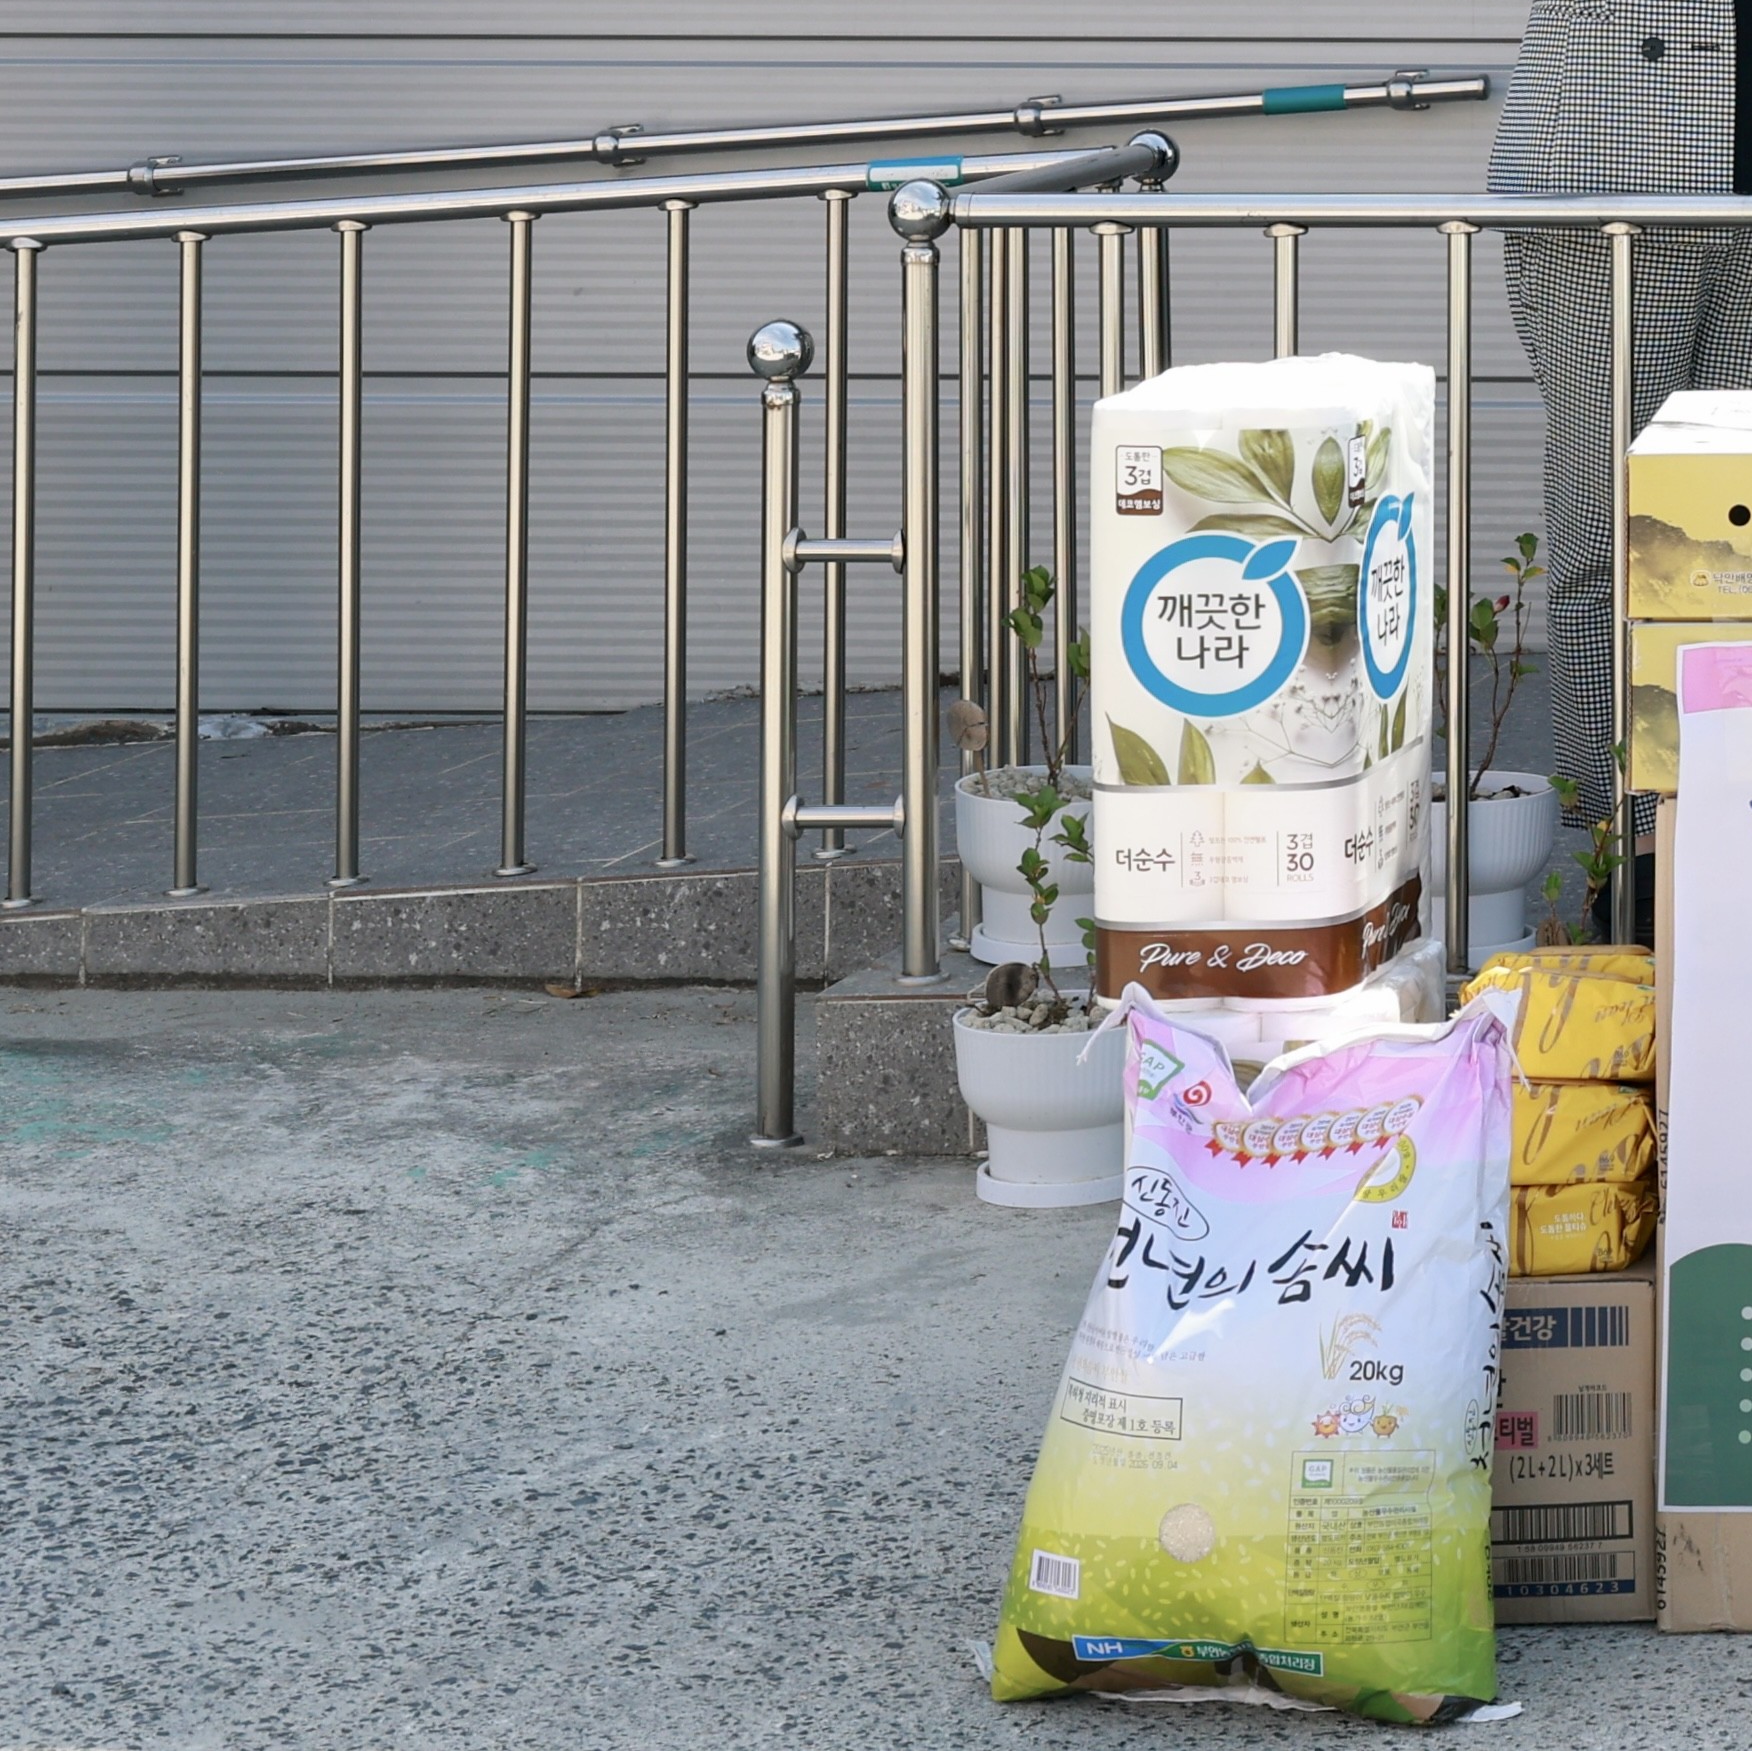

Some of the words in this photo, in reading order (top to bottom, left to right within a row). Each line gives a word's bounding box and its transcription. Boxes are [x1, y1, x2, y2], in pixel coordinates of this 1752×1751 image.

[1124, 465, 1152, 486] 3겹
[1371, 554, 1405, 603] 깨끗한
[1157, 593, 1266, 631] 깨끗한
[1377, 602, 1401, 646] 나라
[1176, 635, 1250, 670] 나라
[1286, 833, 1314, 850] 3겹
[1344, 825, 1374, 864] 더순수
[1115, 848, 1176, 872] 더순수
[1286, 852, 1314, 872] 30
[1286, 873, 1314, 882] ROLLS
[1140, 943, 1202, 973] Pure
[1207, 945, 1233, 969] &
[1236, 942, 1309, 972] Deco
[1131, 1174, 1191, 1229] 신동진
[1348, 1355, 1406, 1387] 20kg
[1496, 1416, 1534, 1447] 티벌
